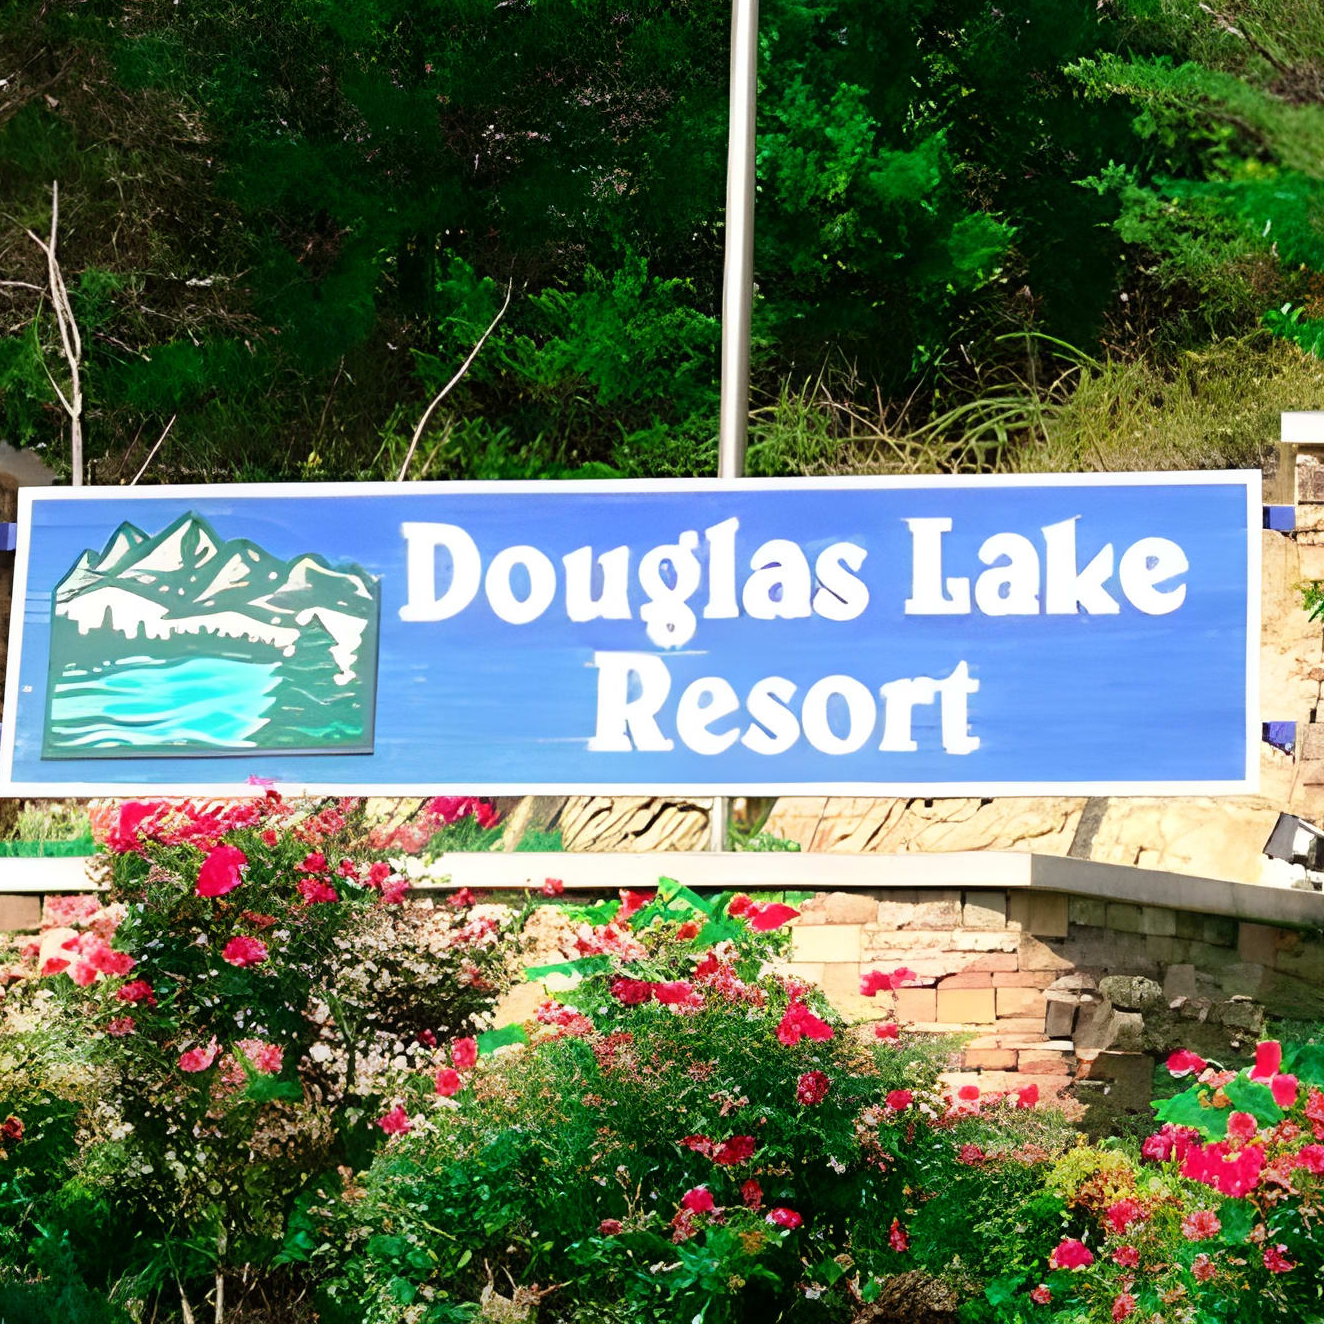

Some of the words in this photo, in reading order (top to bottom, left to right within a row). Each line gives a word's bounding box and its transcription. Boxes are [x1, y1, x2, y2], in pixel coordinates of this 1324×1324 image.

[399, 518, 869, 649] Douglas
[903, 516, 1189, 617] Lake
[591, 653, 981, 756] Resort
